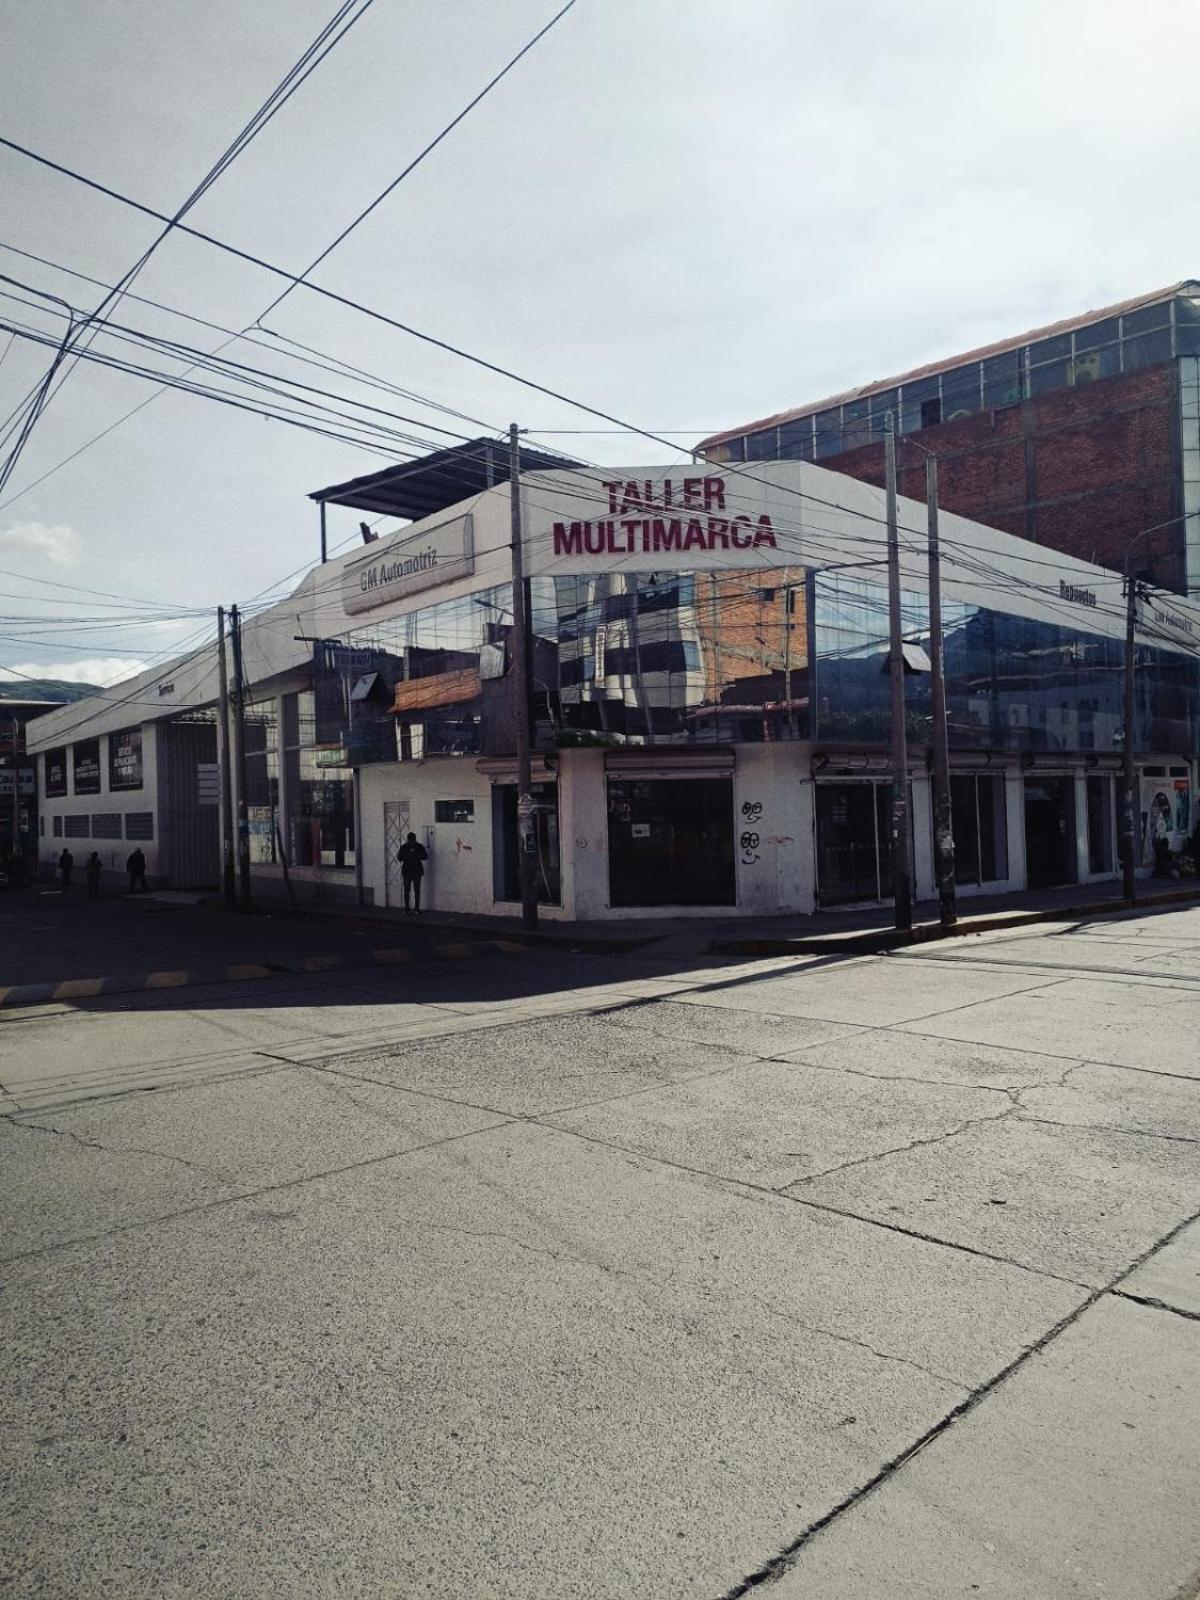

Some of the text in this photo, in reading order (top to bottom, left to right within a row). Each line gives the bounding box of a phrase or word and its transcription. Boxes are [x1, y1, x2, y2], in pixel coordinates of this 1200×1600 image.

[602, 477, 726, 514] TALLER
[553, 515, 777, 555] MULTIMARCA
[380, 545, 437, 585] Automotriz
